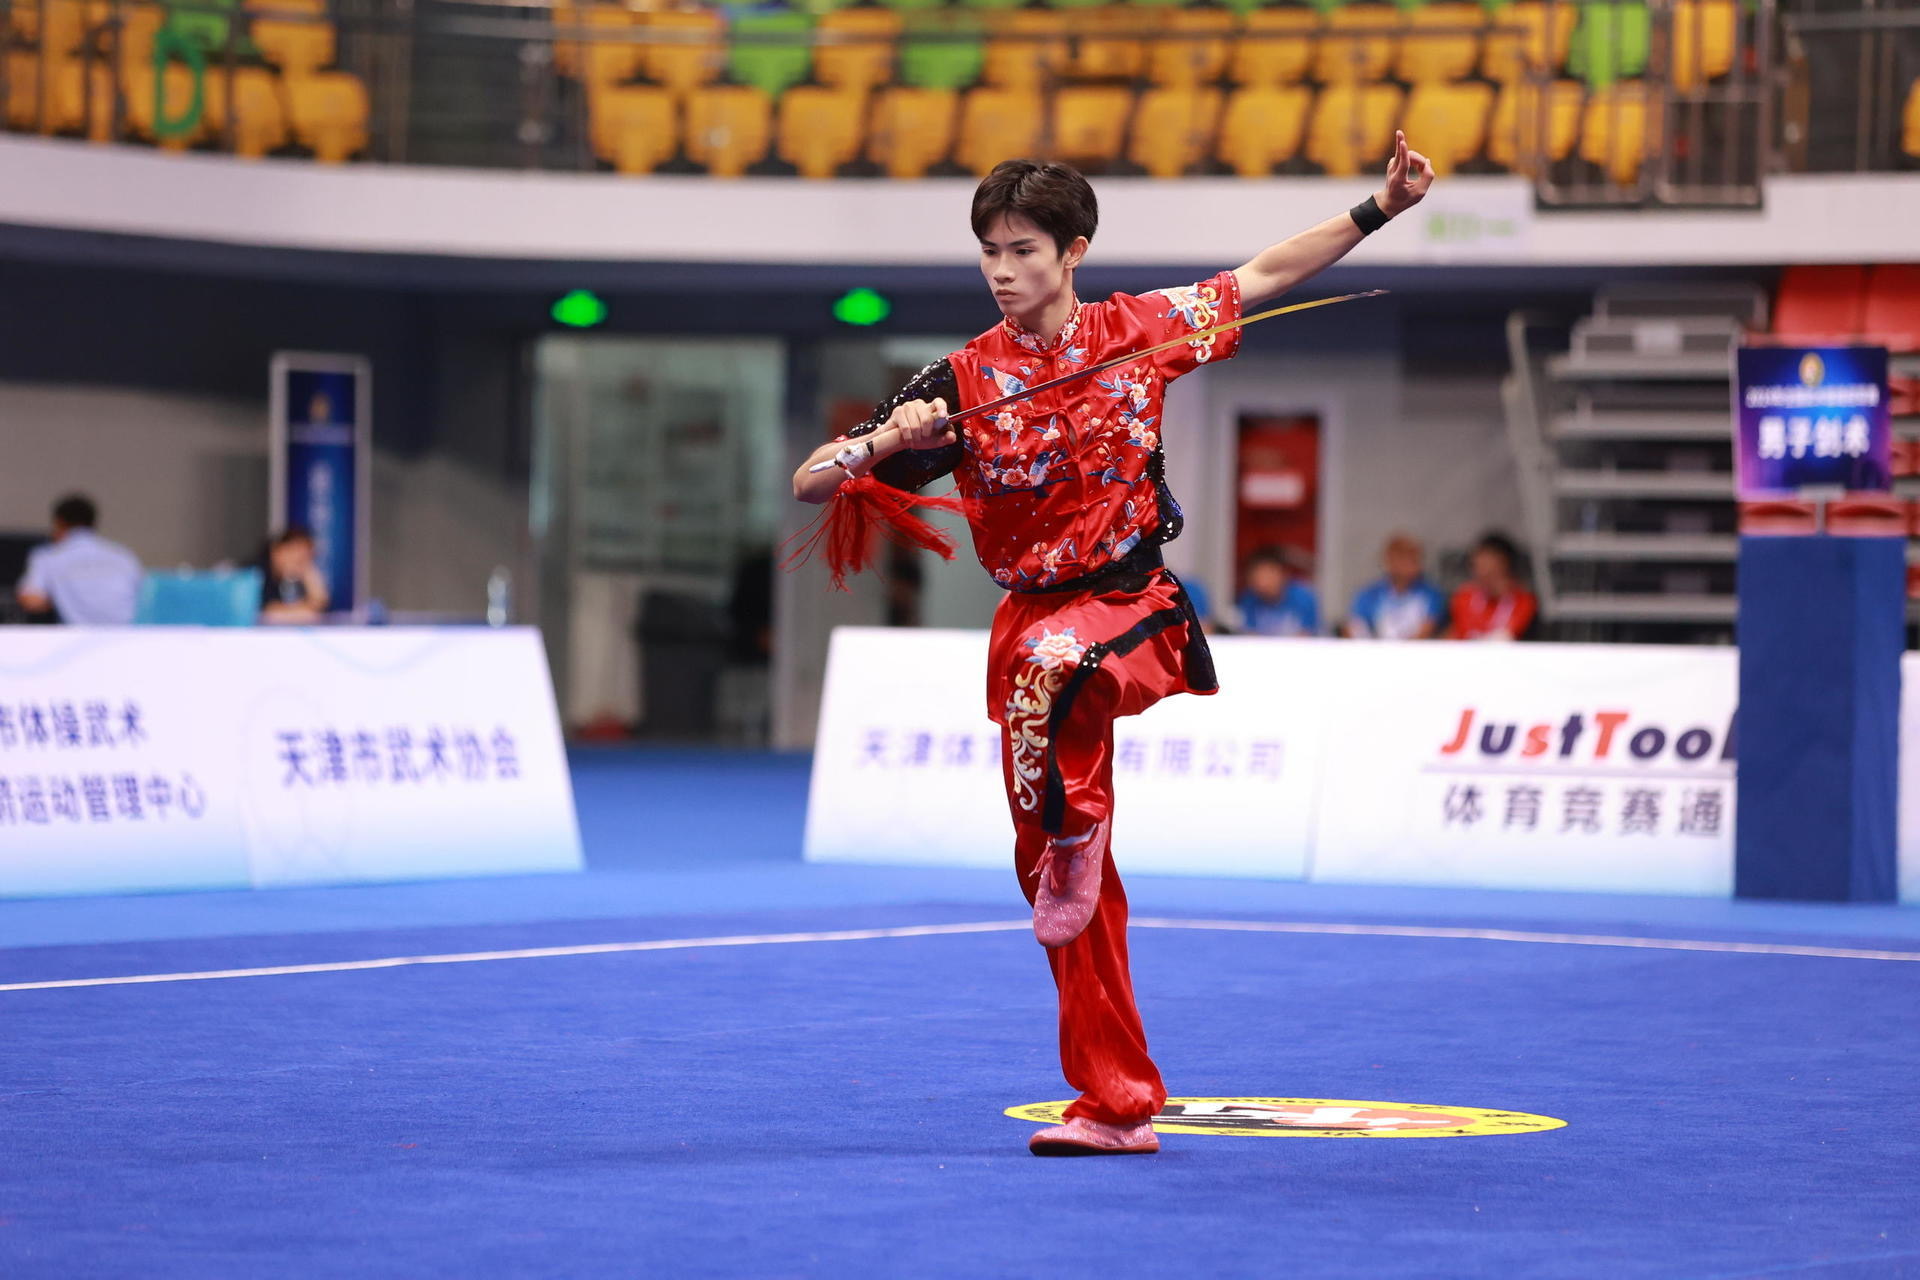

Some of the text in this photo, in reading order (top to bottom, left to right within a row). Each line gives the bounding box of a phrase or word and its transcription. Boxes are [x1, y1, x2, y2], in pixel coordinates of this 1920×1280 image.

[278, 728, 519, 786] 天津市武术协会
[1444, 785, 1723, 837] 体育竞赛通
